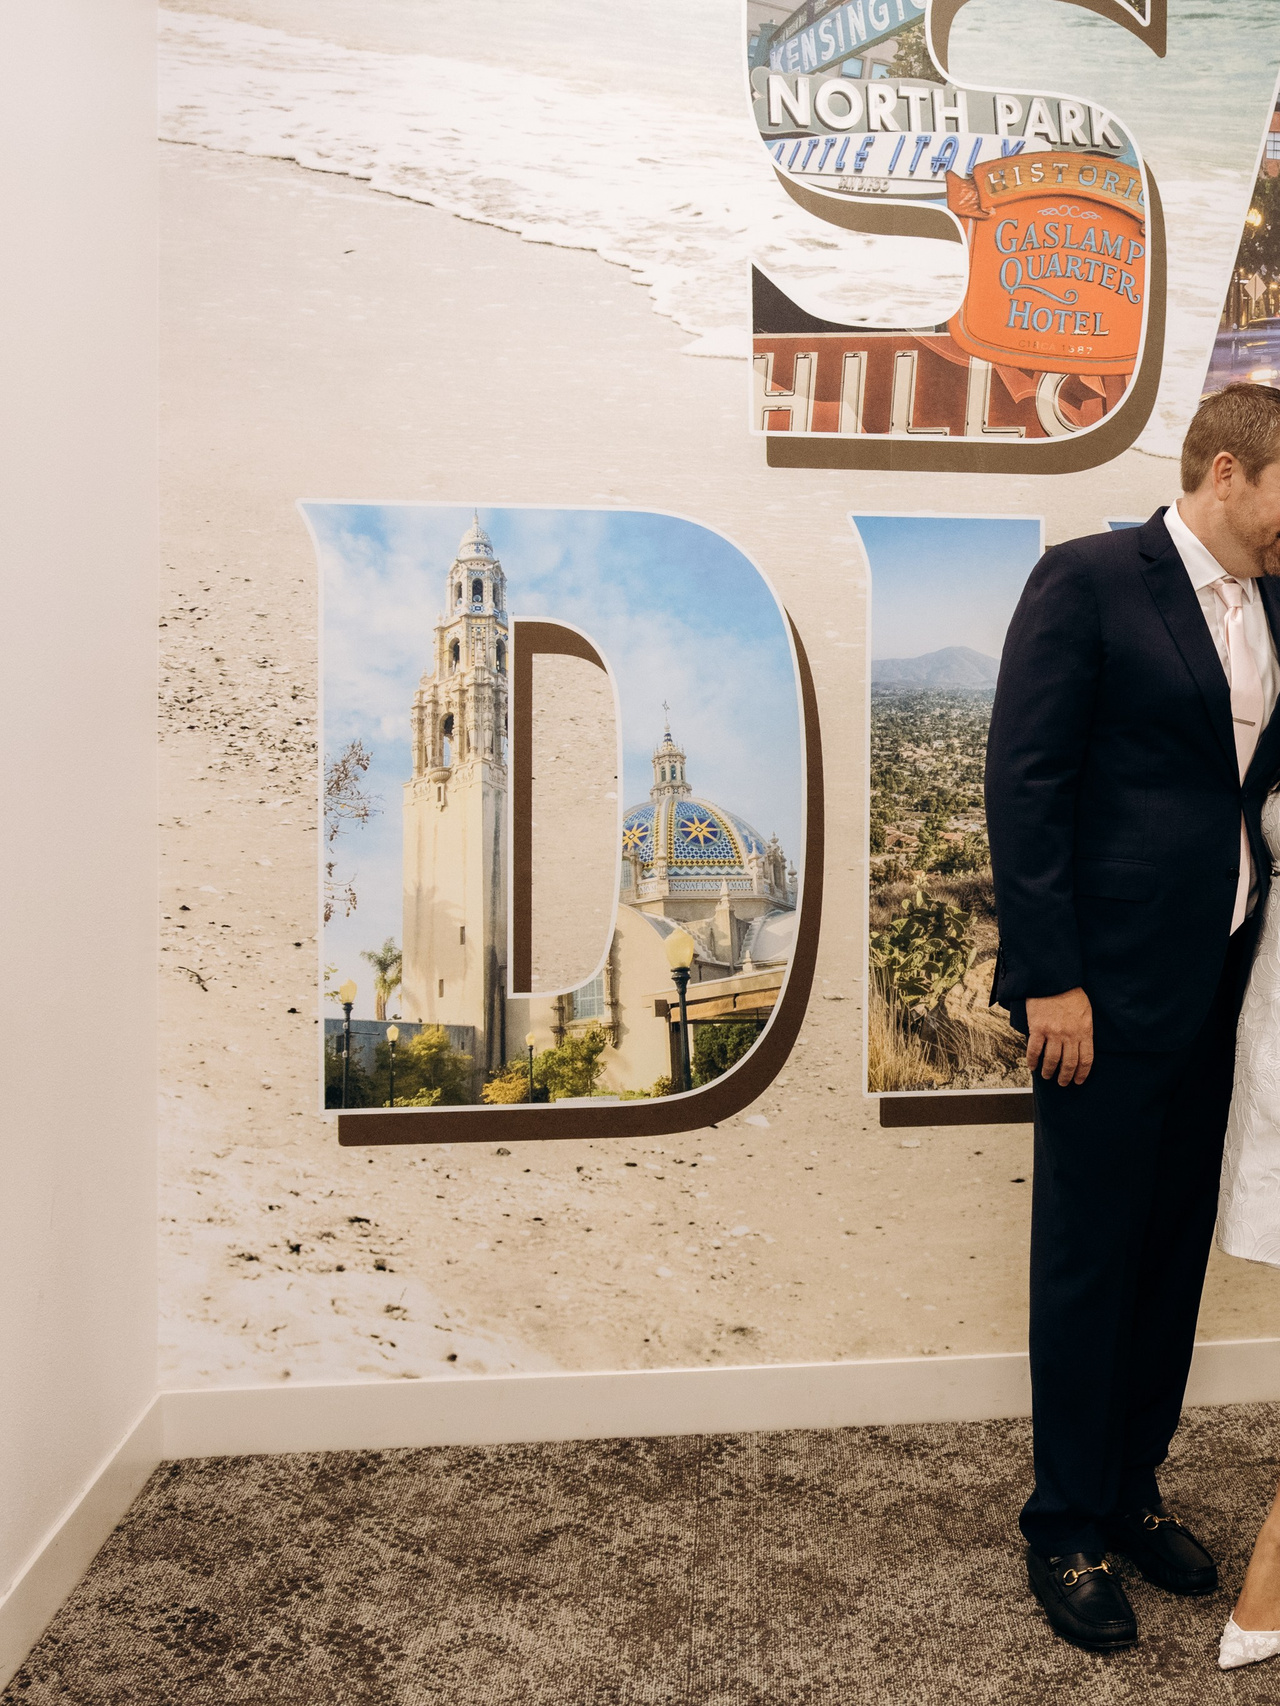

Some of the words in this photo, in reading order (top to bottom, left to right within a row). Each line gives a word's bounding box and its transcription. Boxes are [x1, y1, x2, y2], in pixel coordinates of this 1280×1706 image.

[770, 0, 926, 74] KENSING
[767, 74, 969, 133] NORTH
[993, 93, 1124, 148] PARK
[773, 135, 875, 171] LITTLE
[994, 218, 1146, 266] GASLAMP
[999, 252, 1141, 305] QUARTER
[1007, 298, 1110, 337] HOTEL
